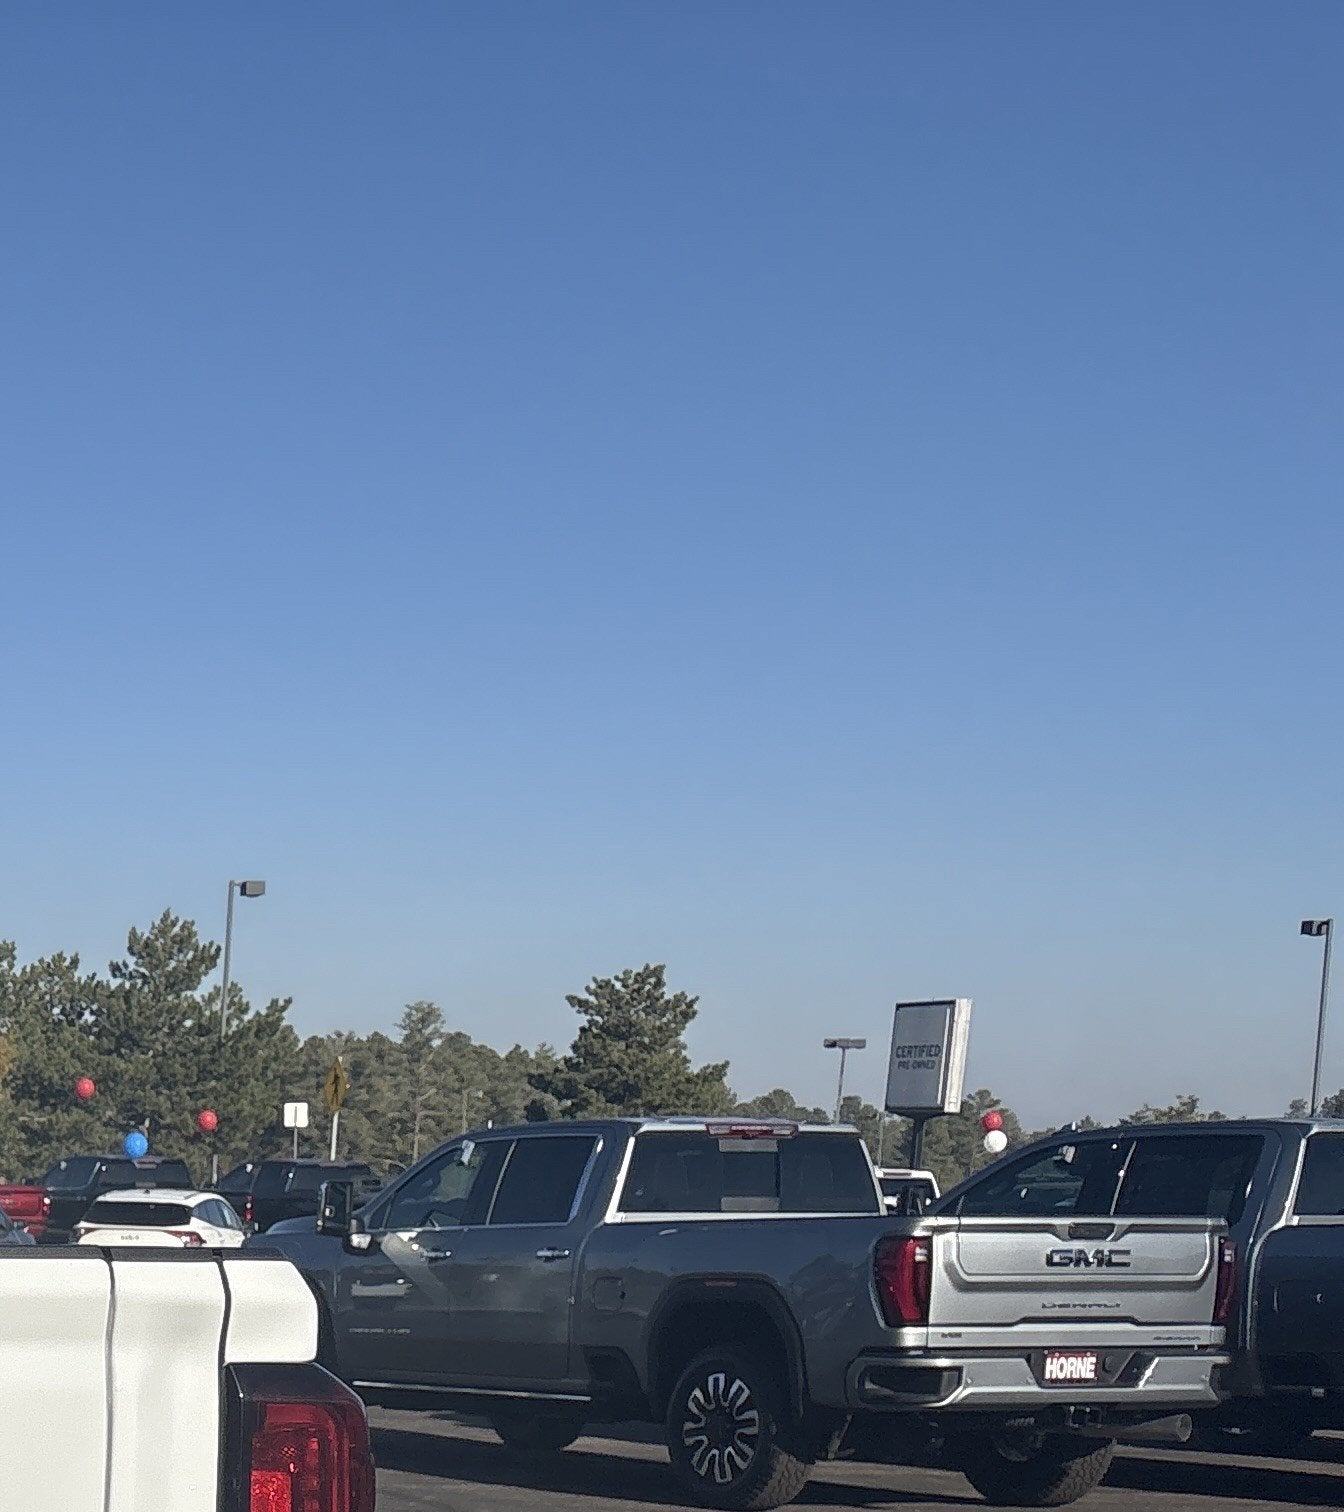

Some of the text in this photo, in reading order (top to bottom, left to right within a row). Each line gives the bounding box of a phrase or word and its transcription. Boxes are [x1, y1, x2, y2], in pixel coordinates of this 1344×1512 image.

[895, 1044, 941, 1059] CERTIFIED
[1046, 1249, 1132, 1268] GMC
[1045, 1356, 1097, 1379] HORNE
